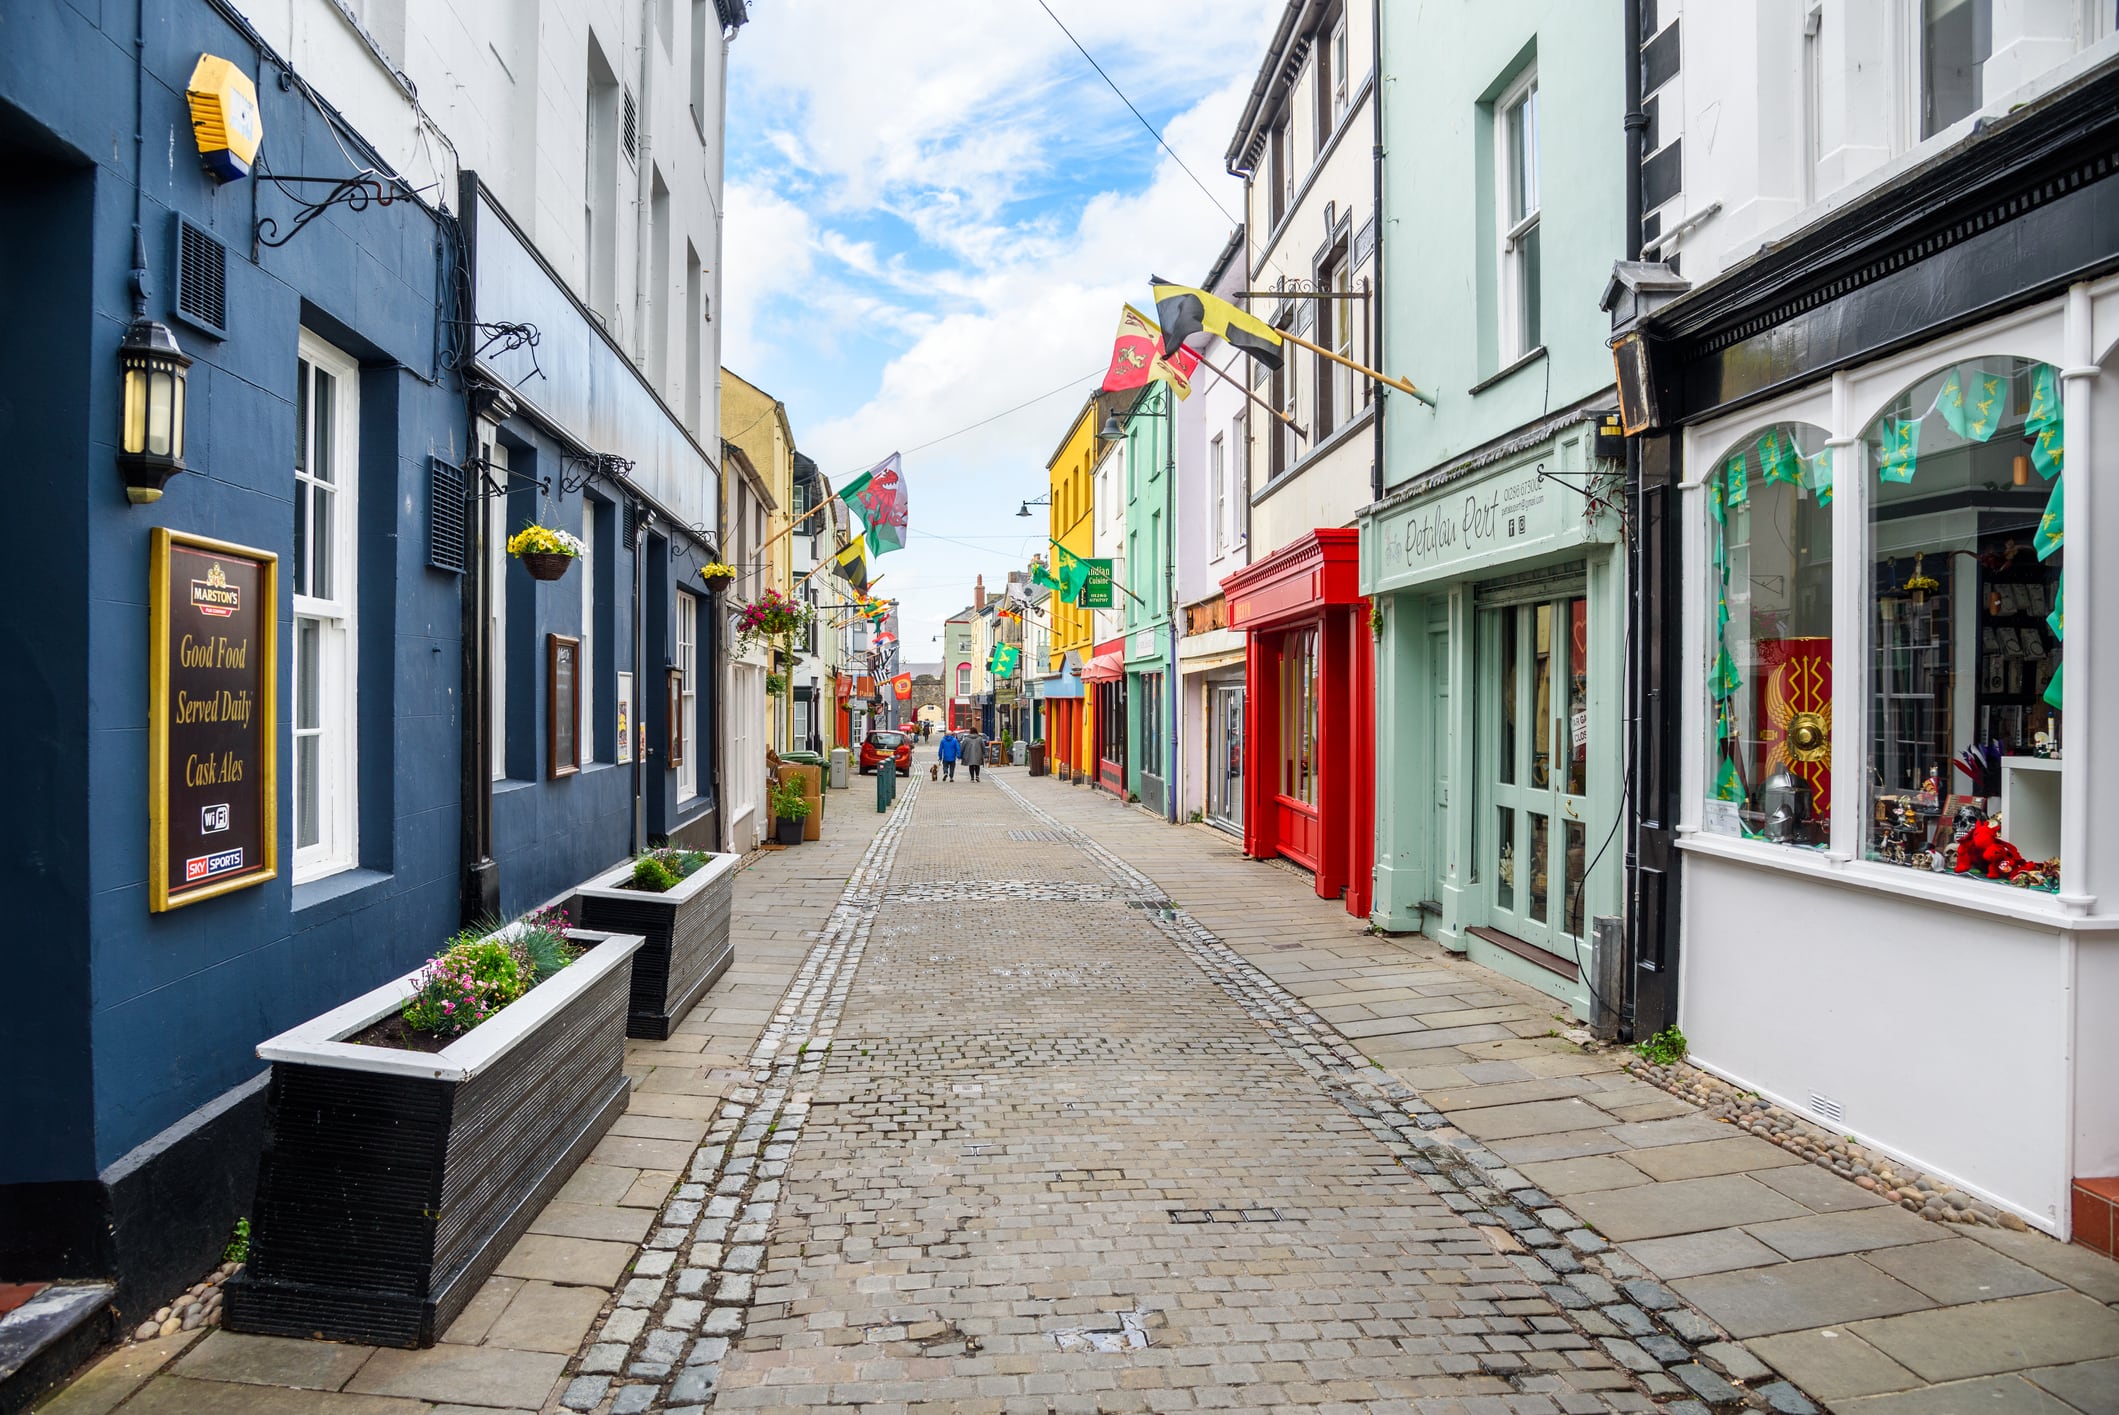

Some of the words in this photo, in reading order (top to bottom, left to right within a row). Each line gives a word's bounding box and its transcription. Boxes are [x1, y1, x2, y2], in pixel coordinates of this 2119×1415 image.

[1462, 489, 1499, 550] Pert
[194, 587, 238, 605] MARSTON'S
[180, 634, 215, 668] Good
[216, 636, 247, 669] Food
[176, 690, 220, 724] Served
[221, 690, 252, 730] Daily
[186, 752, 217, 788] Cask
[217, 751, 244, 784] Ales
[189, 861, 206, 876] SKY
[209, 852, 241, 871] SPORTS
